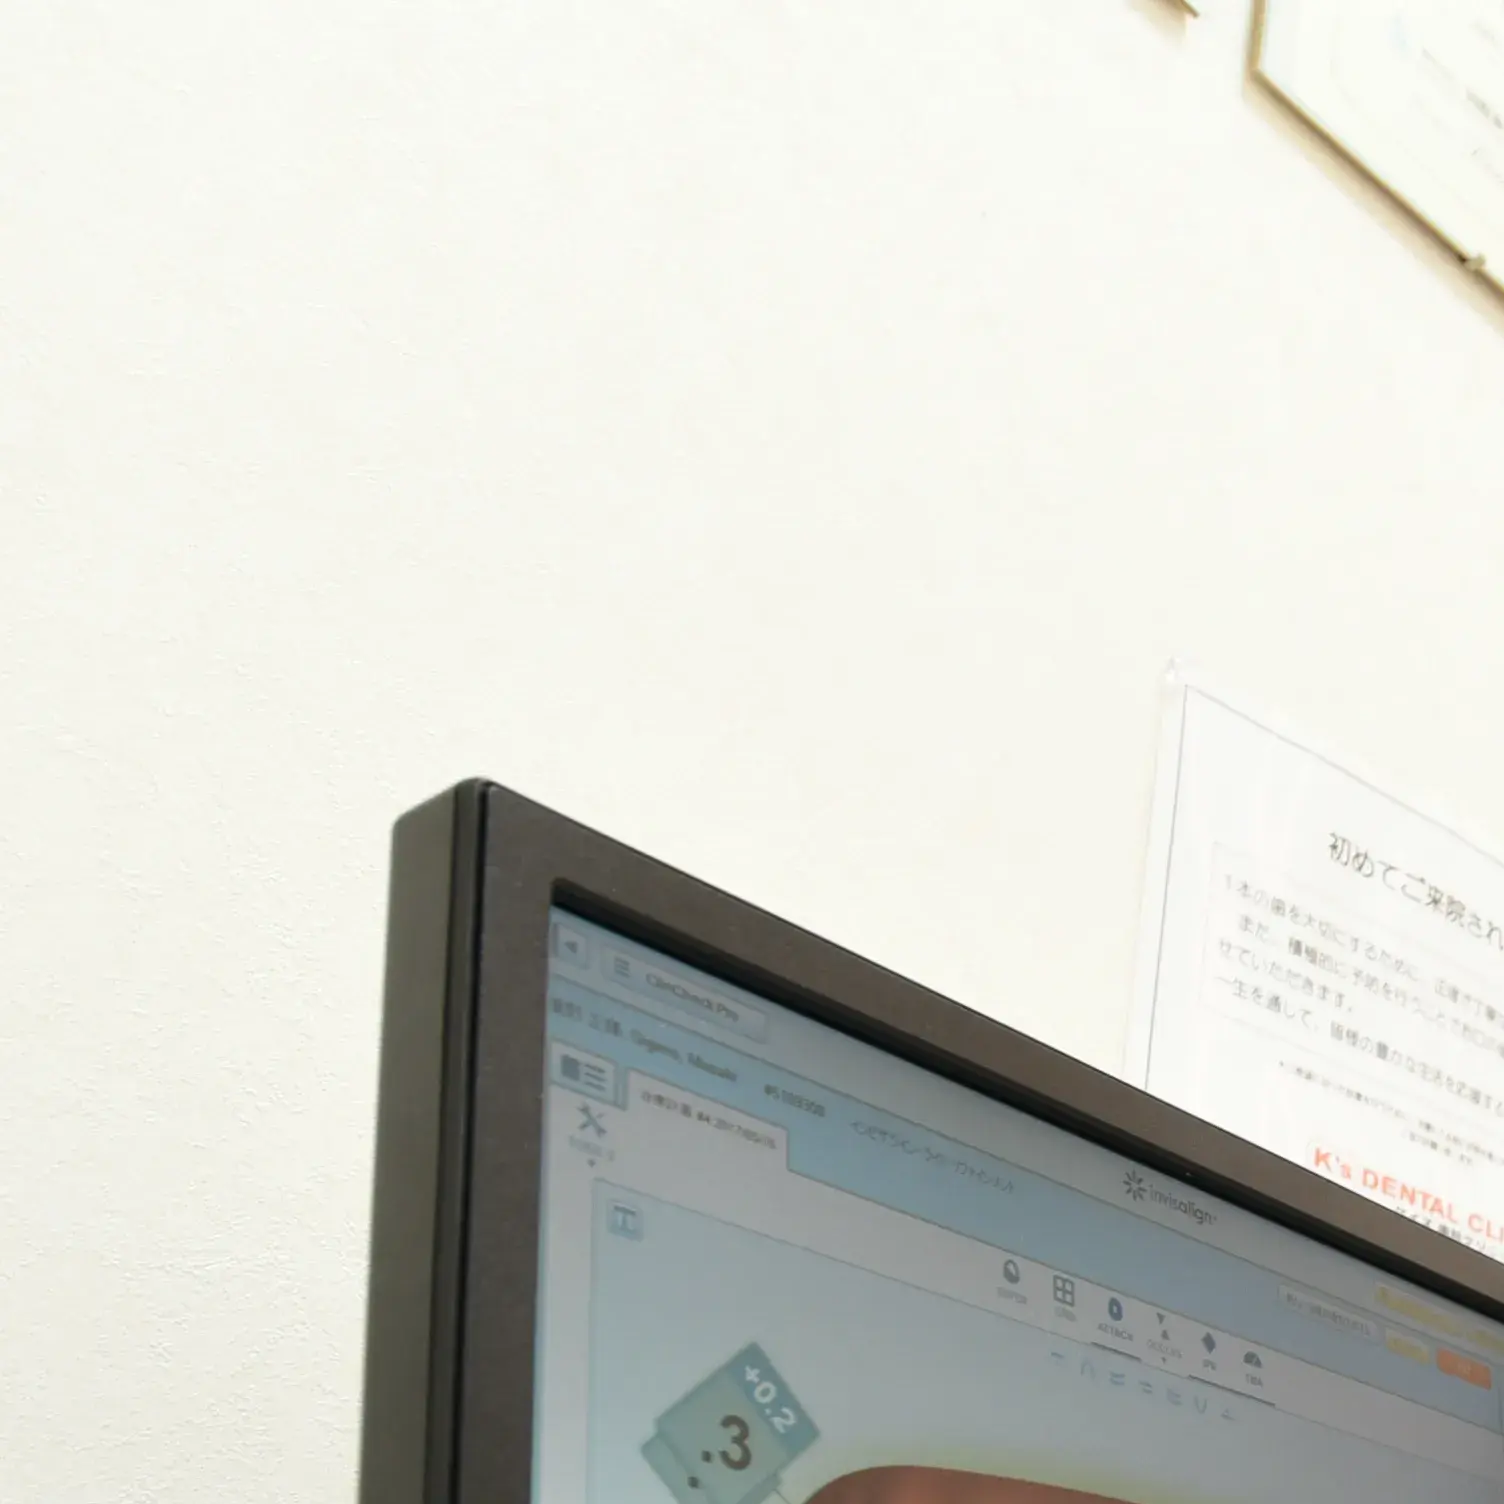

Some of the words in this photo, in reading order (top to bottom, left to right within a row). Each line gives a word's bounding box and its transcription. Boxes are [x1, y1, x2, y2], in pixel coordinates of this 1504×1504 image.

[1147, 1183, 1215, 1226] invisalign
[1312, 1147, 1353, 1180] K's
[1361, 1167, 1460, 1225] DENTAL
[744, 1365, 797, 1434] +0.2
